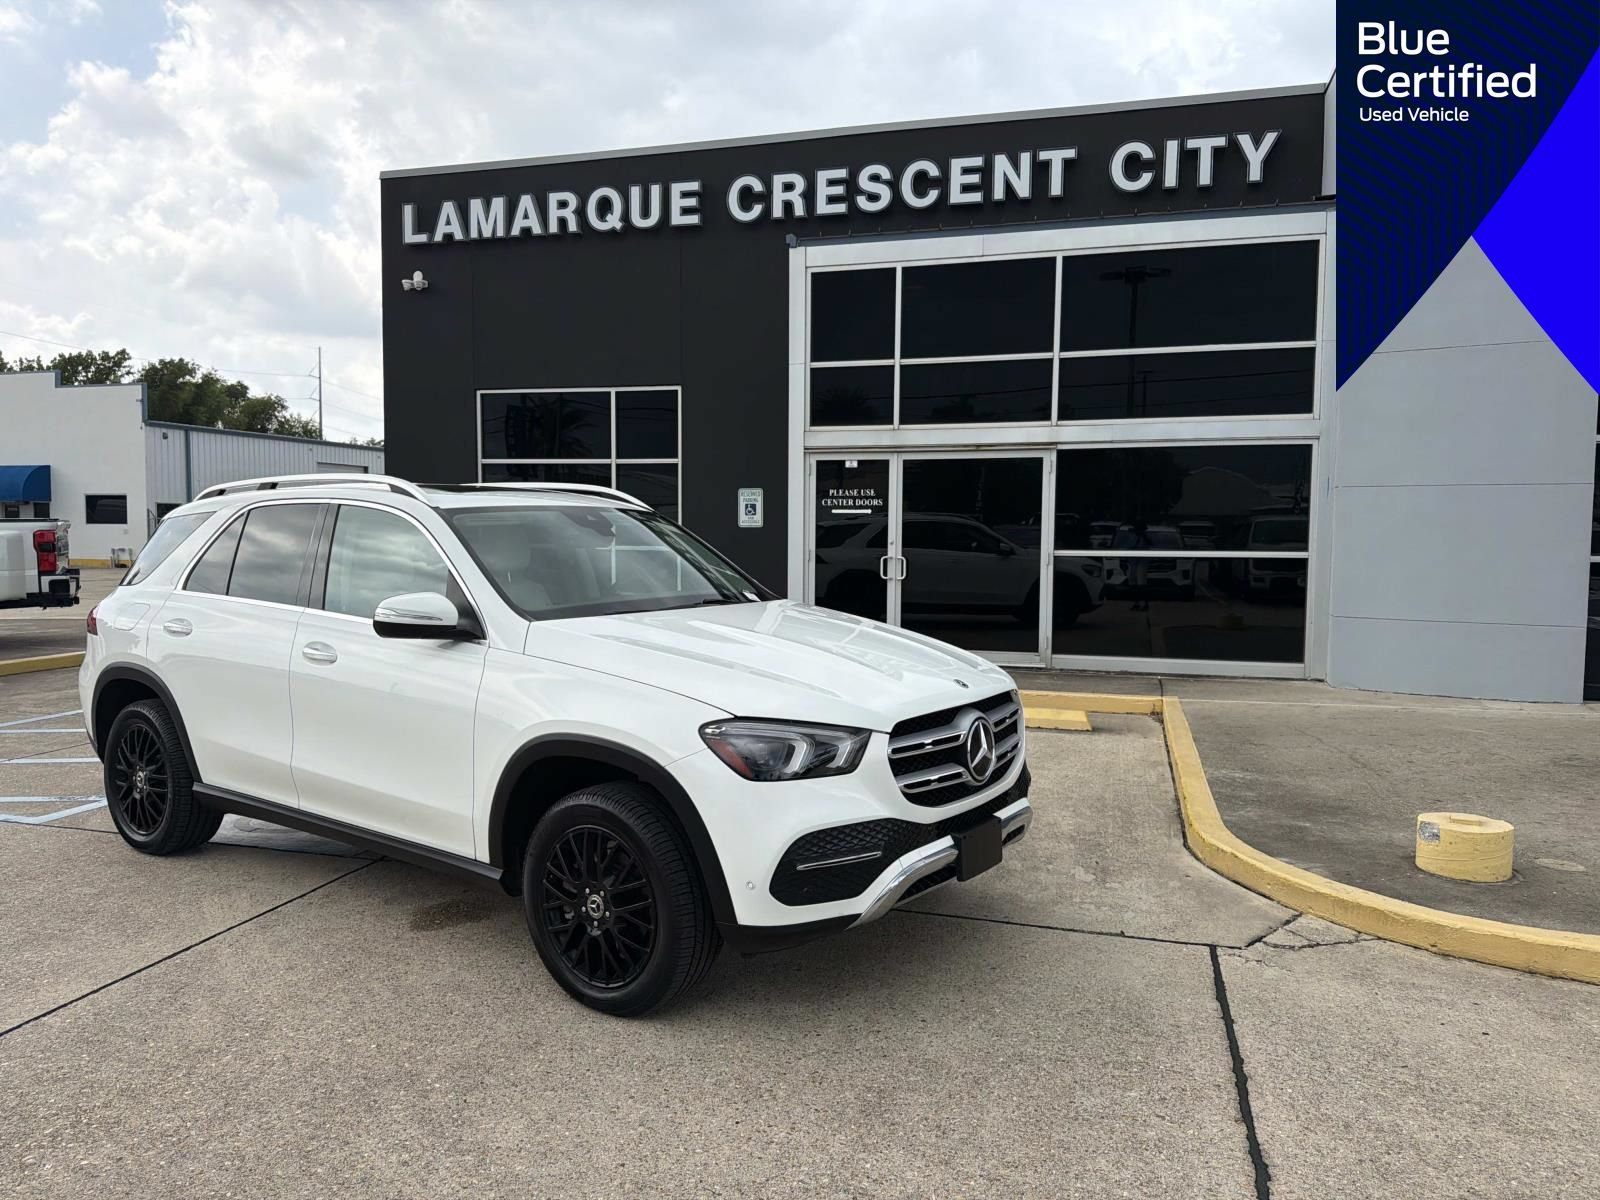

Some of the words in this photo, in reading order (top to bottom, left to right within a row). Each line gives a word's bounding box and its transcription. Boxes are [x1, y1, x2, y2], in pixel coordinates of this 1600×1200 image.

[402, 181, 701, 244] LAMARQUE
[728, 146, 1077, 222] CRESCENT
[1109, 129, 1282, 192] CITY
[829, 488, 859, 497] PLEASE
[861, 488, 876, 497] USE
[821, 498, 854, 507] CENTER
[855, 498, 884, 507] DOORS
